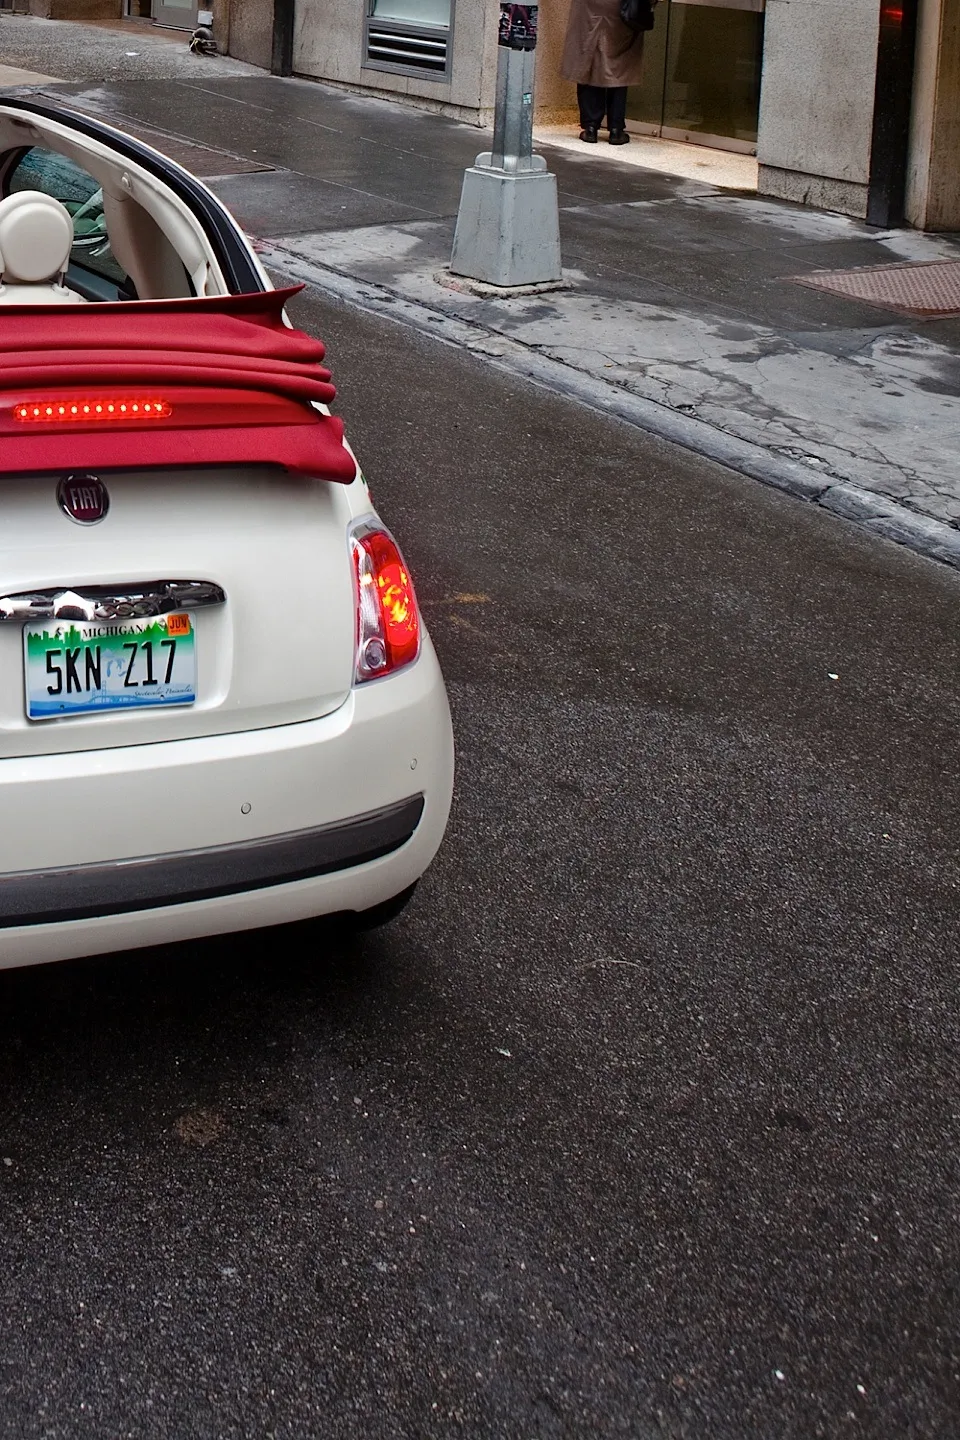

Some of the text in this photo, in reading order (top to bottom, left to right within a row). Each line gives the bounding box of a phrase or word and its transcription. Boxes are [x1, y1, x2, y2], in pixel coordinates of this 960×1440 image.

[69, 487, 99, 511] FIAT
[82, 623, 144, 639] MICHIGAN
[169, 618, 187, 630] JUN
[46, 639, 177, 697] 5KN Z17
